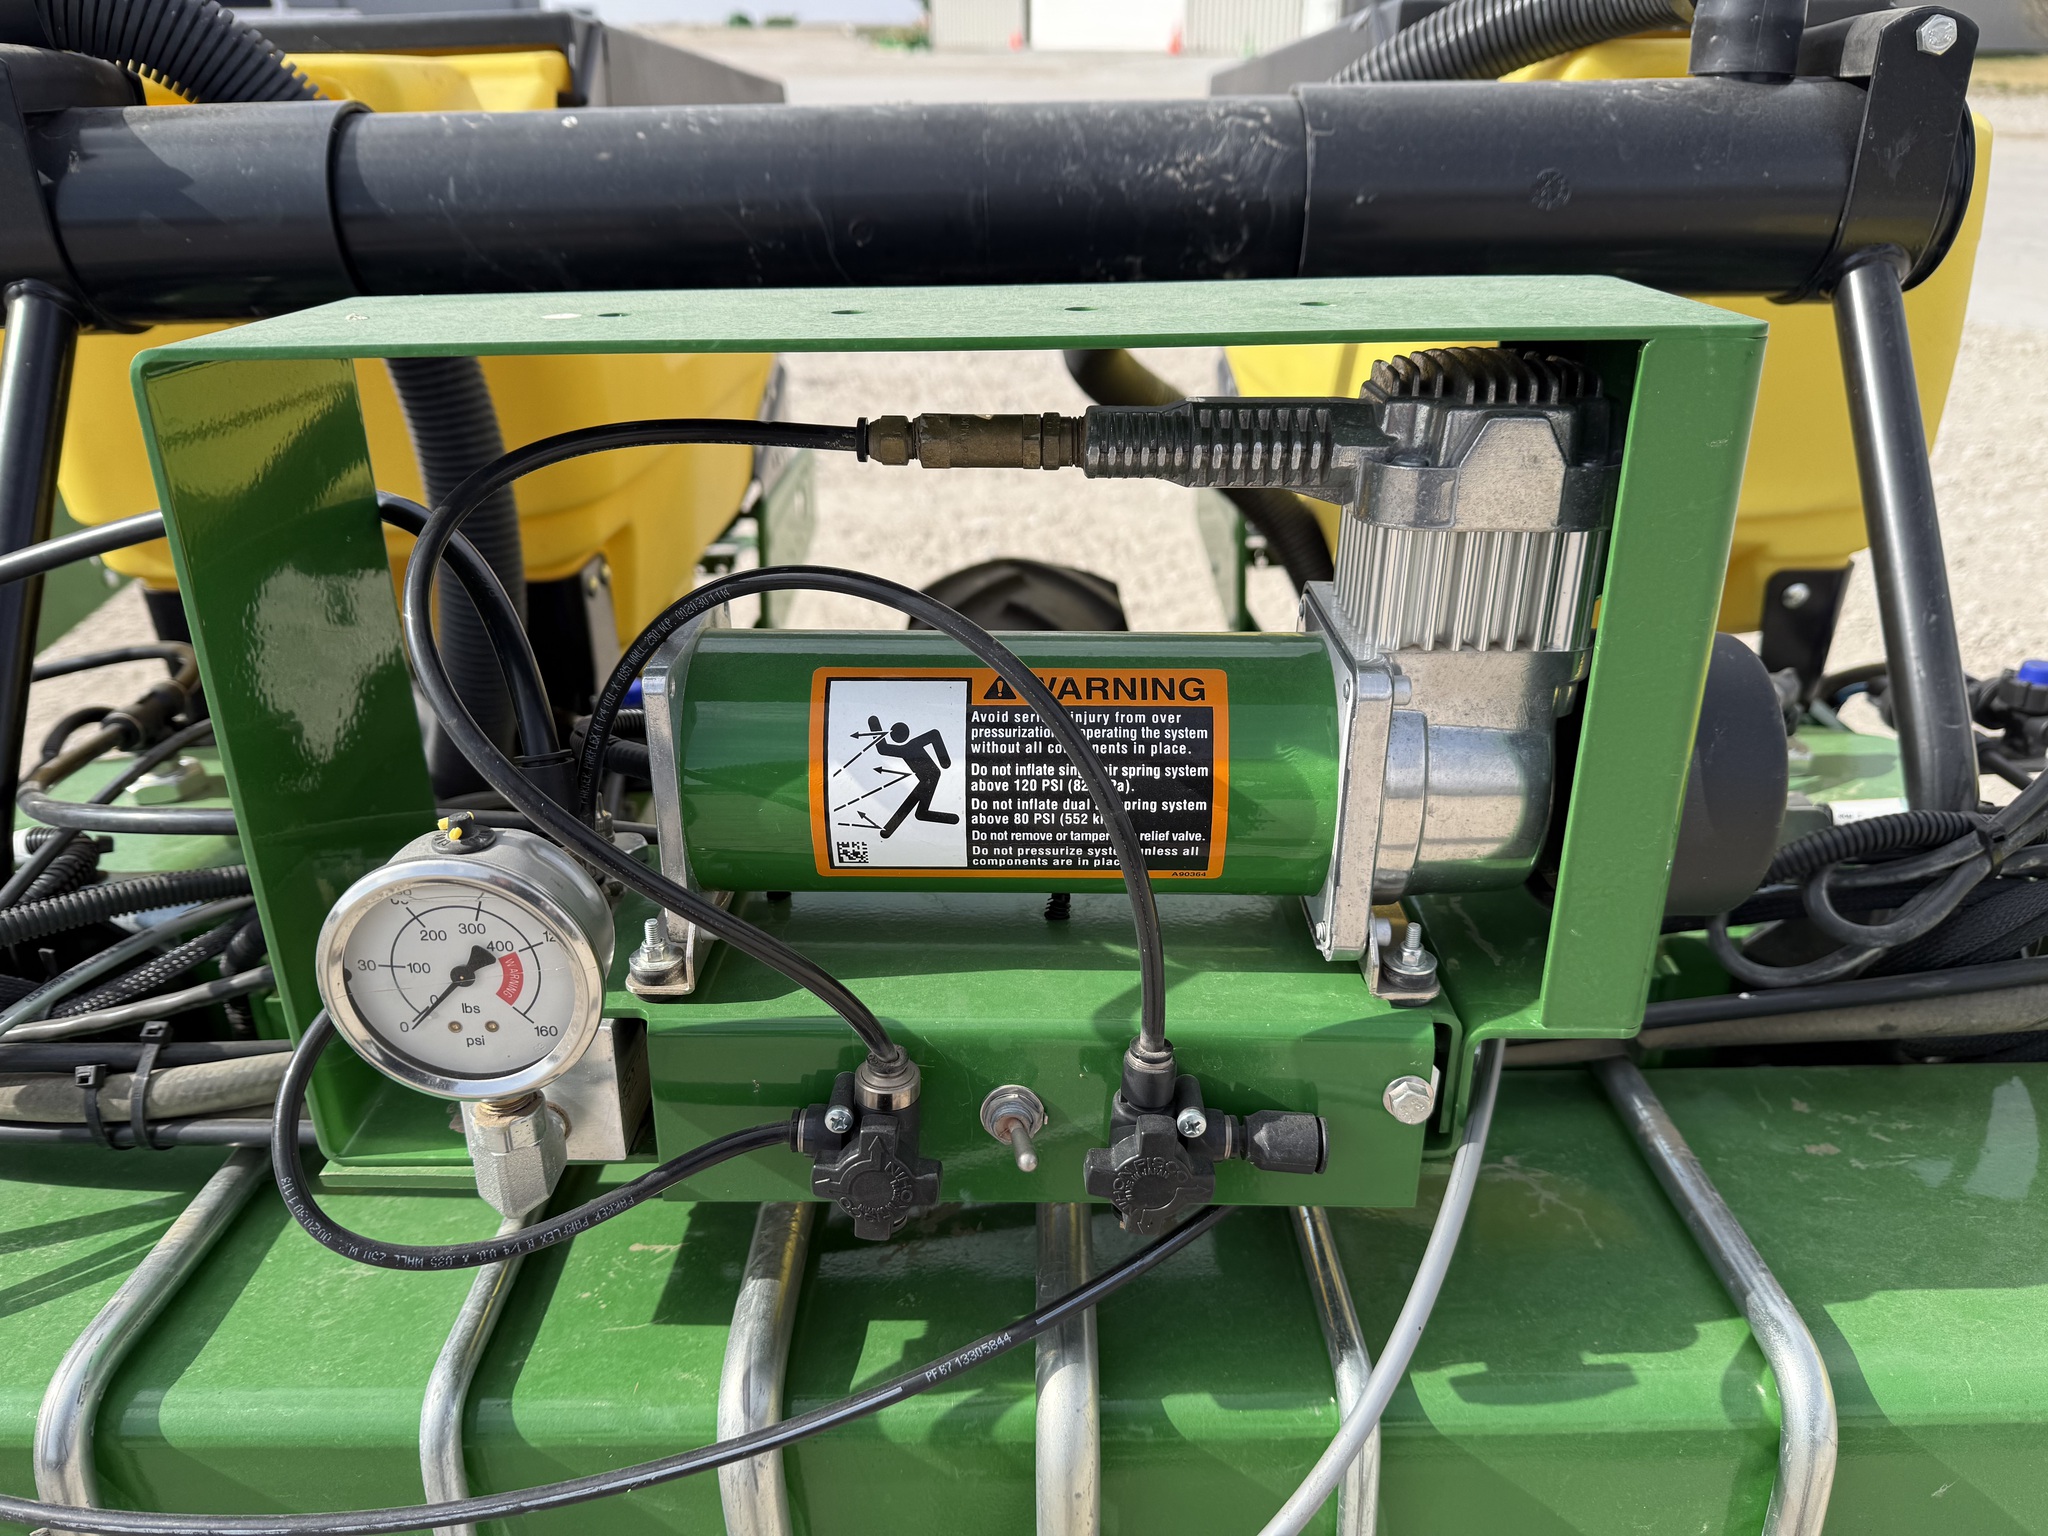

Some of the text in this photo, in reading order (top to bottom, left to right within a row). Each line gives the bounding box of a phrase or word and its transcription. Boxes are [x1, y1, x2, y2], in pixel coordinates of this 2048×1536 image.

[613, 680, 622, 692] X
[619, 664, 633, 685] .035
[628, 645, 649, 667] WALL
[643, 629, 659, 647] 250
[971, 711, 1009, 723] Avoid
[1071, 711, 1110, 726] injury
[1115, 711, 1146, 724] from
[1151, 713, 1182, 724] over
[1141, 726, 1161, 739] the
[1164, 727, 1208, 742] system
[970, 741, 1021, 754] without
[1025, 741, 1042, 754] all
[1133, 742, 1146, 755] in
[1150, 742, 1192, 757] place.
[970, 763, 988, 776] Do
[991, 763, 1012, 776] not
[1015, 763, 1055, 776] inflate
[1121, 764, 1161, 780] spring
[1164, 764, 1209, 780] system
[970, 778, 1010, 792] above
[1013, 778, 1037, 792] 120
[1041, 779, 1063, 792] PSI
[1067, 779, 1089, 795] (82
[970, 798, 988, 811] Do
[992, 798, 1013, 811] not
[1017, 798, 1059, 811] inflate
[1062, 798, 1091, 811] dual
[1122, 799, 1158, 813] pring
[1161, 799, 1208, 813] system
[970, 812, 1010, 825] above
[1013, 812, 1030, 825] 80
[1033, 812, 1055, 825] PSI
[1059, 812, 1089, 827] (552
[971, 829, 1206, 843] Do not remove or tamper relief valve.
[972, 845, 989, 856] Do
[993, 845, 1013, 856] not
[1017, 845, 1083, 858] pressurize
[1182, 846, 1200, 856] all
[972, 857, 1120, 868] components are in plac
[419, 929, 448, 942] 200
[458, 923, 487, 936] 300
[486, 940, 515, 953] 400
[357, 959, 377, 972] 30
[406, 962, 432, 975] 100
[502, 957, 520, 999] WARNING
[430, 994, 439, 1007] 0
[461, 1002, 481, 1015] lbs
[399, 1021, 410, 1034] 0
[534, 1025, 559, 1038] 160
[466, 1035, 486, 1048] psi
[1112, 1166, 1138, 1216] NIHON
[1133, 1156, 1189, 1183] PISCO
[594, 1196, 635, 1222] PARKER
[540, 1215, 589, 1244] PARFLEX
[393, 1254, 424, 1268] WALL
[925, 1369, 939, 1383] PF
[954, 1332, 1013, 1369] 13305844
